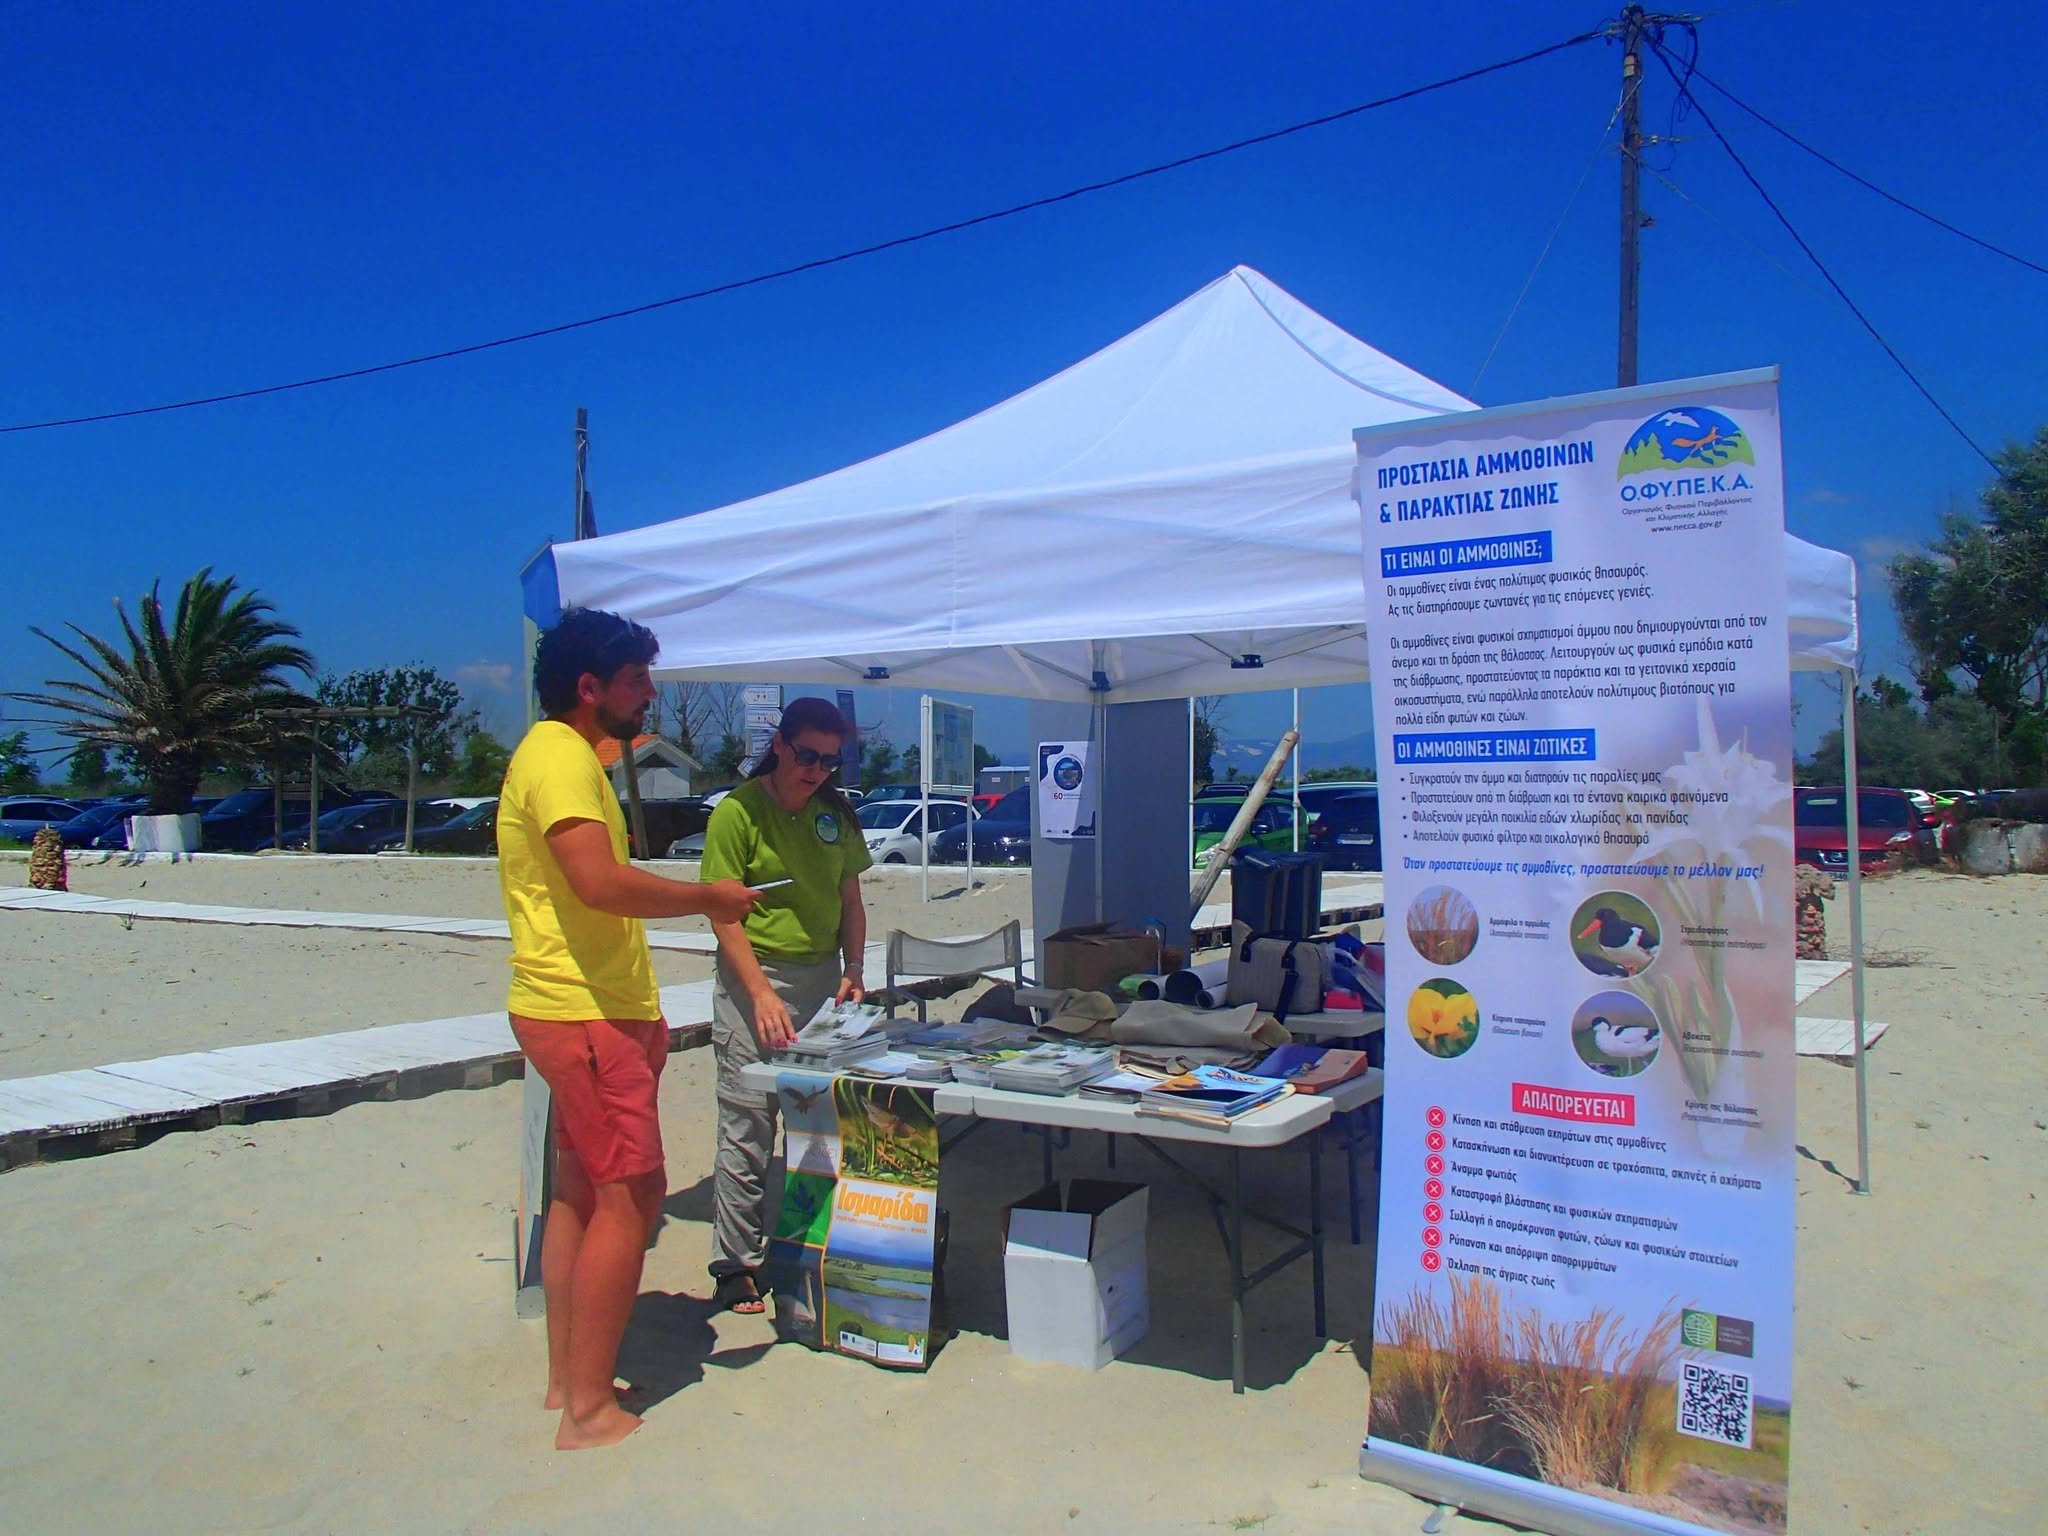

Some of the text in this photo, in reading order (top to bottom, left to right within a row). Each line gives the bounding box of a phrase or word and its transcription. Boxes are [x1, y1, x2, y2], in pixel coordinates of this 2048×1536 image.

[1377, 441, 1593, 488] ΠΡΟΣΤΑΣΙΑ ΑΜΜΟΘΙΝΩΝ
[1379, 482, 1558, 522] & ΠΑΡΑΚΤΙΑΣ ΖΩΝΗΣ
[1619, 473, 1753, 501] Ο.ΦΥ.ΠΕ.Κ.Α.
[1650, 520, 1722, 532] www.necca.gov.gr
[1385, 539, 1542, 569] ΤΙ ΕΙΝΑΙ ΟΙ ΑΜΜΟΘΙΝΕΣ;
[1386, 563, 1650, 598] Οι αμμοθίνες είναι ένας πολύτιμος φυσικός θησαυρός.
[1387, 583, 1656, 618] Ας τις διατηρήσουμε ζωντανές για τις επόμενες γενιές.
[1389, 613, 1767, 651] Οι αμμοθίνες είναι φυσικοί σχηματισμοί άμμου που δημιουργούνται από τον
[1390, 634, 1753, 670] άνεμο και τη δράση της θάλασσας. Λειτουργούν ως φυσικά εμπόδια κατά
[1392, 657, 1736, 689] της διάβρωσης, προστατεύοντας τα παράκτια και τα γειτονικά χερσαία
[1393, 679, 1735, 707] οικοσυστήματα, ενώ παράλληλα αποτελούν πολύτιμους βιοτόπους για
[1395, 707, 1528, 726] πολλά είδη φυτών και ζώων.
[1397, 737, 1587, 757] ΟΙ ΑΜΜΟΘΙΝΕΣ ΕΙΝΑΙ ΖΩΤΙΚΕΣ
[1409, 767, 1661, 786] Συγκρατούν την άμμο και διατηρούν τις παραλίες μας
[1410, 788, 1729, 806] Προστατεύουν από τη διάβρωση και τα έντονα καιρικά φαινόμενα
[1411, 809, 1689, 827] Φιλοξενούν μεγάλη ποικιλία ειδών χλωρίδας και πανίδας
[1412, 828, 1650, 848] Αποτελούν φυσικό φίλτρο και οικολογικό θησαυρό
[1401, 855, 1764, 880] Όταν προστατεύουμε τις αμμοθίνες, προστατεύουμε το μέλλον μας!
[1521, 1090, 1625, 1117] ΑΠΑΓΟΡΕΥΕΤΑΙ
[1451, 1112, 1667, 1153] Κίνηση και στάθμευση οχημάτων στις αμμοθίνες
[1449, 1159, 1517, 1183] Άναμμα φωτιάς
[1451, 1137, 1762, 1190] Κατασκήνωση και διανυκτέρευση σε τροχόσπιτα, σκηνές ή οχήματα
[838, 1183, 928, 1223] Ισμαρίδα
[1450, 1184, 1678, 1231] Καταστροφή βλάστησης και φυσικών σχηματισμών
[1448, 1233, 1617, 1273] Ρύπανση και απόρριψη απορριμμάτων
[1449, 1208, 1739, 1268] Συλλογή ή απομάκρυνση φυτών, ζώων και φυσικών στοιχείων
[1445, 1255, 1555, 1290] Όχληση της άγριας ζωής
